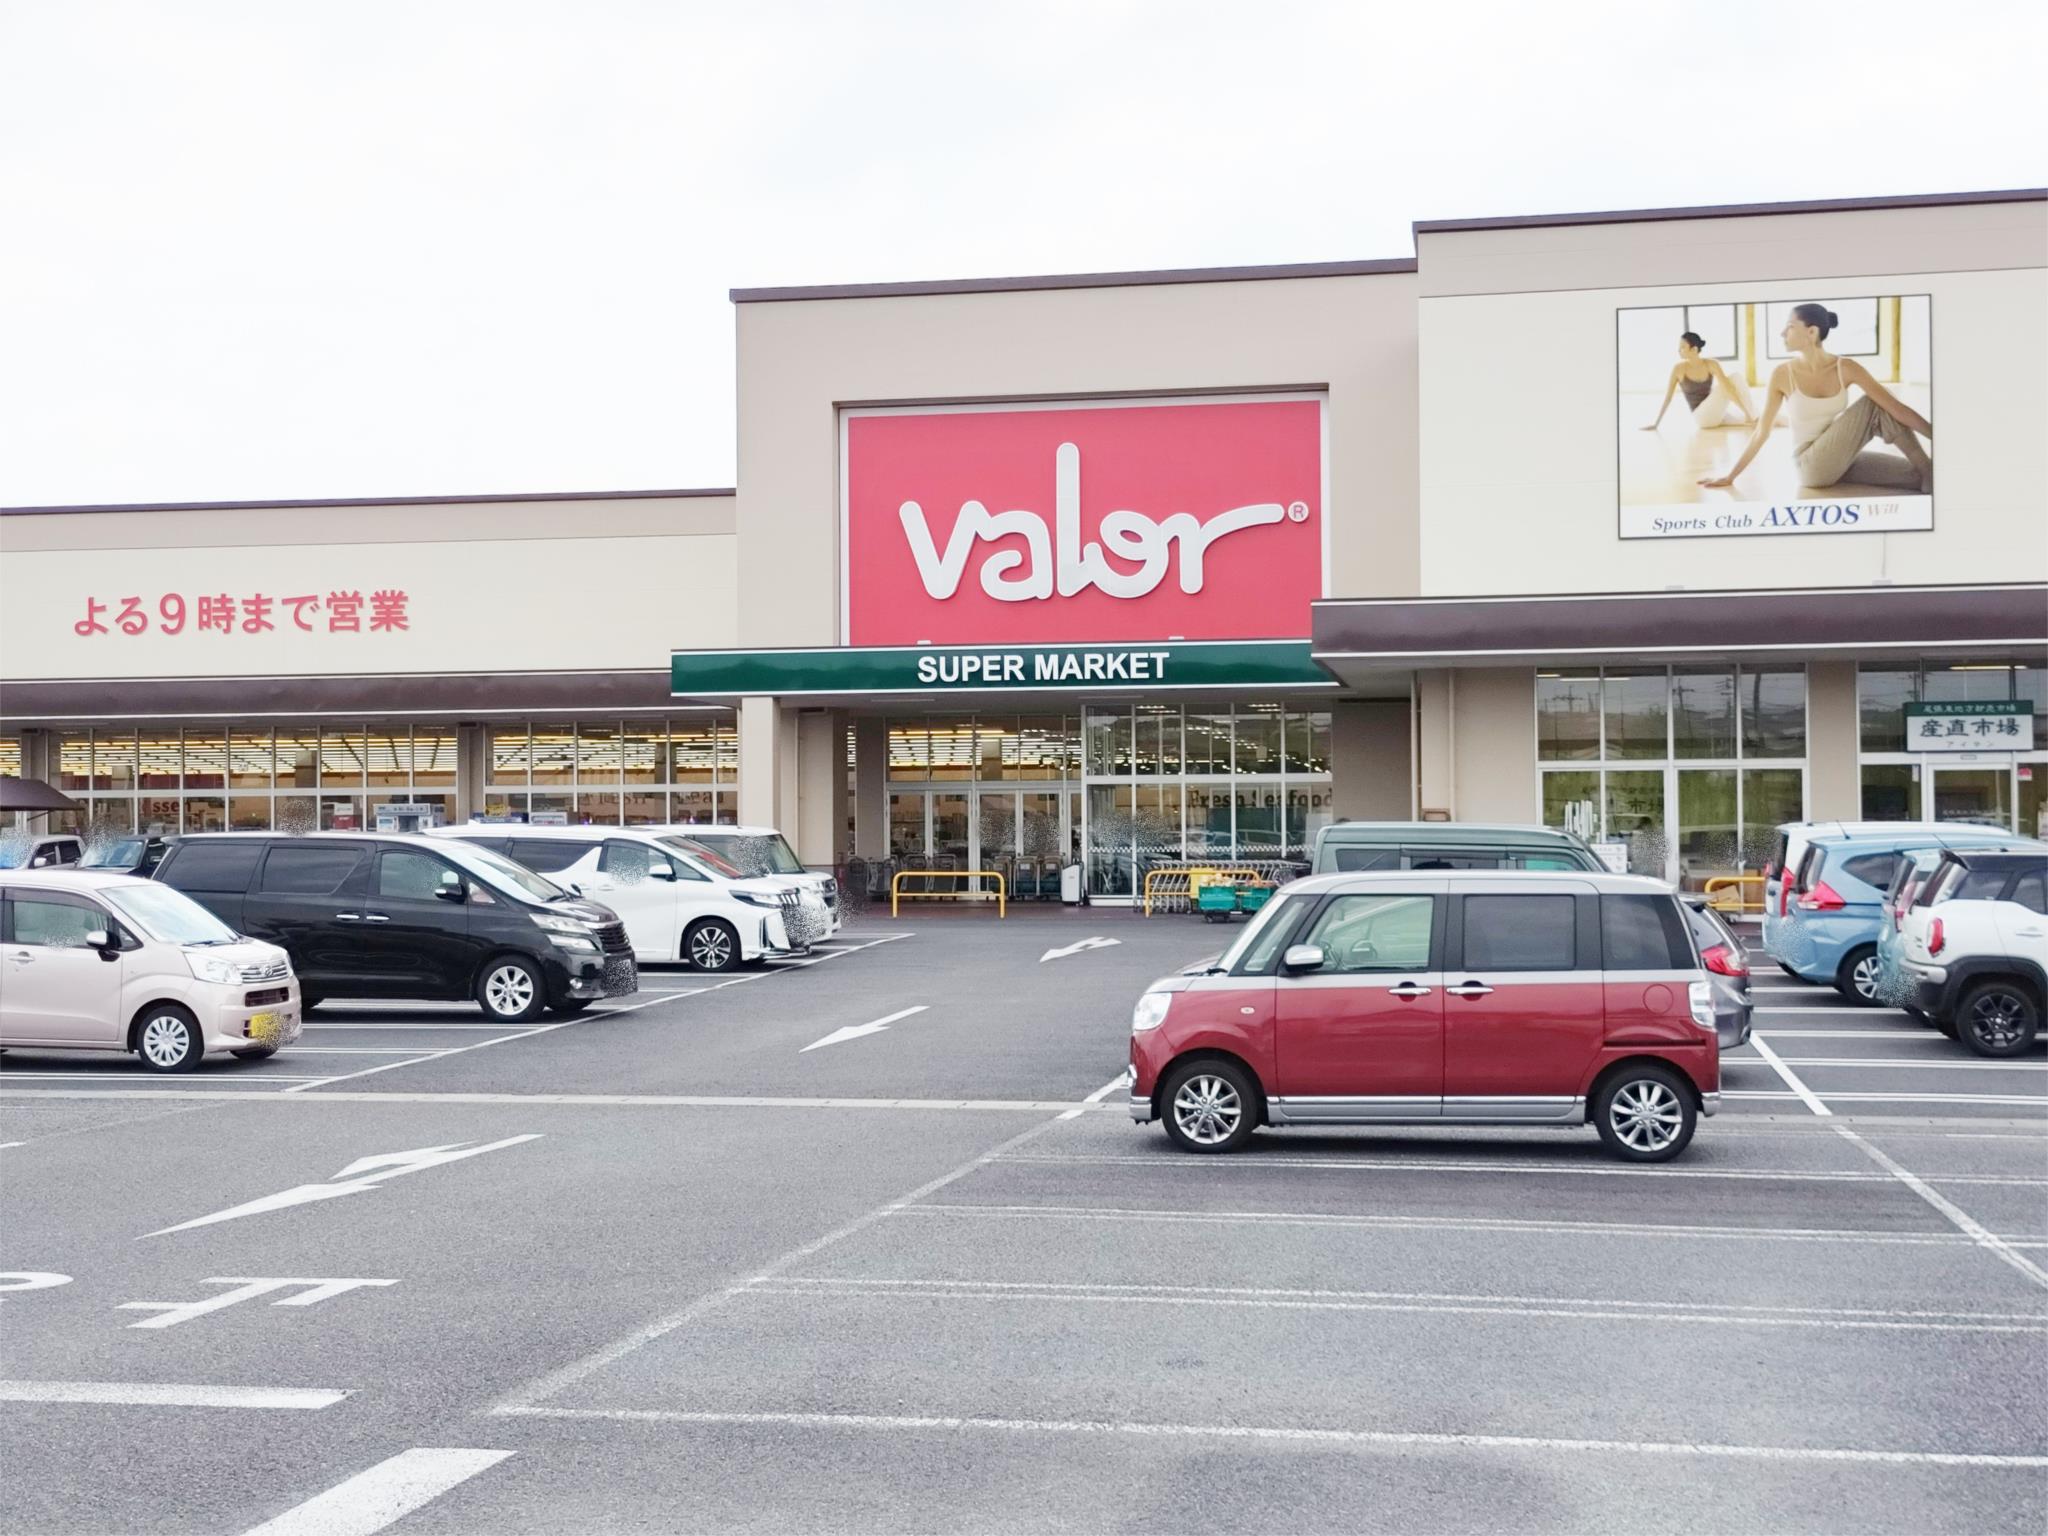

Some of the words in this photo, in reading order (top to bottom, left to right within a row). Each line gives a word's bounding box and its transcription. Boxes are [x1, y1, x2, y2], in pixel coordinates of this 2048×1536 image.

[1652, 517, 1707, 534] Sports
[1715, 514, 1752, 530] Club
[1760, 504, 1860, 528] AXTOS
[1866, 503, 1900, 518] Will
[74, 590, 411, 636] よる9時まで営業
[918, 653, 1025, 684] SUPER
[1034, 652, 1170, 682] MARKET
[1920, 716, 2021, 738] 産直市場
[1187, 790, 1245, 808] Fresh
